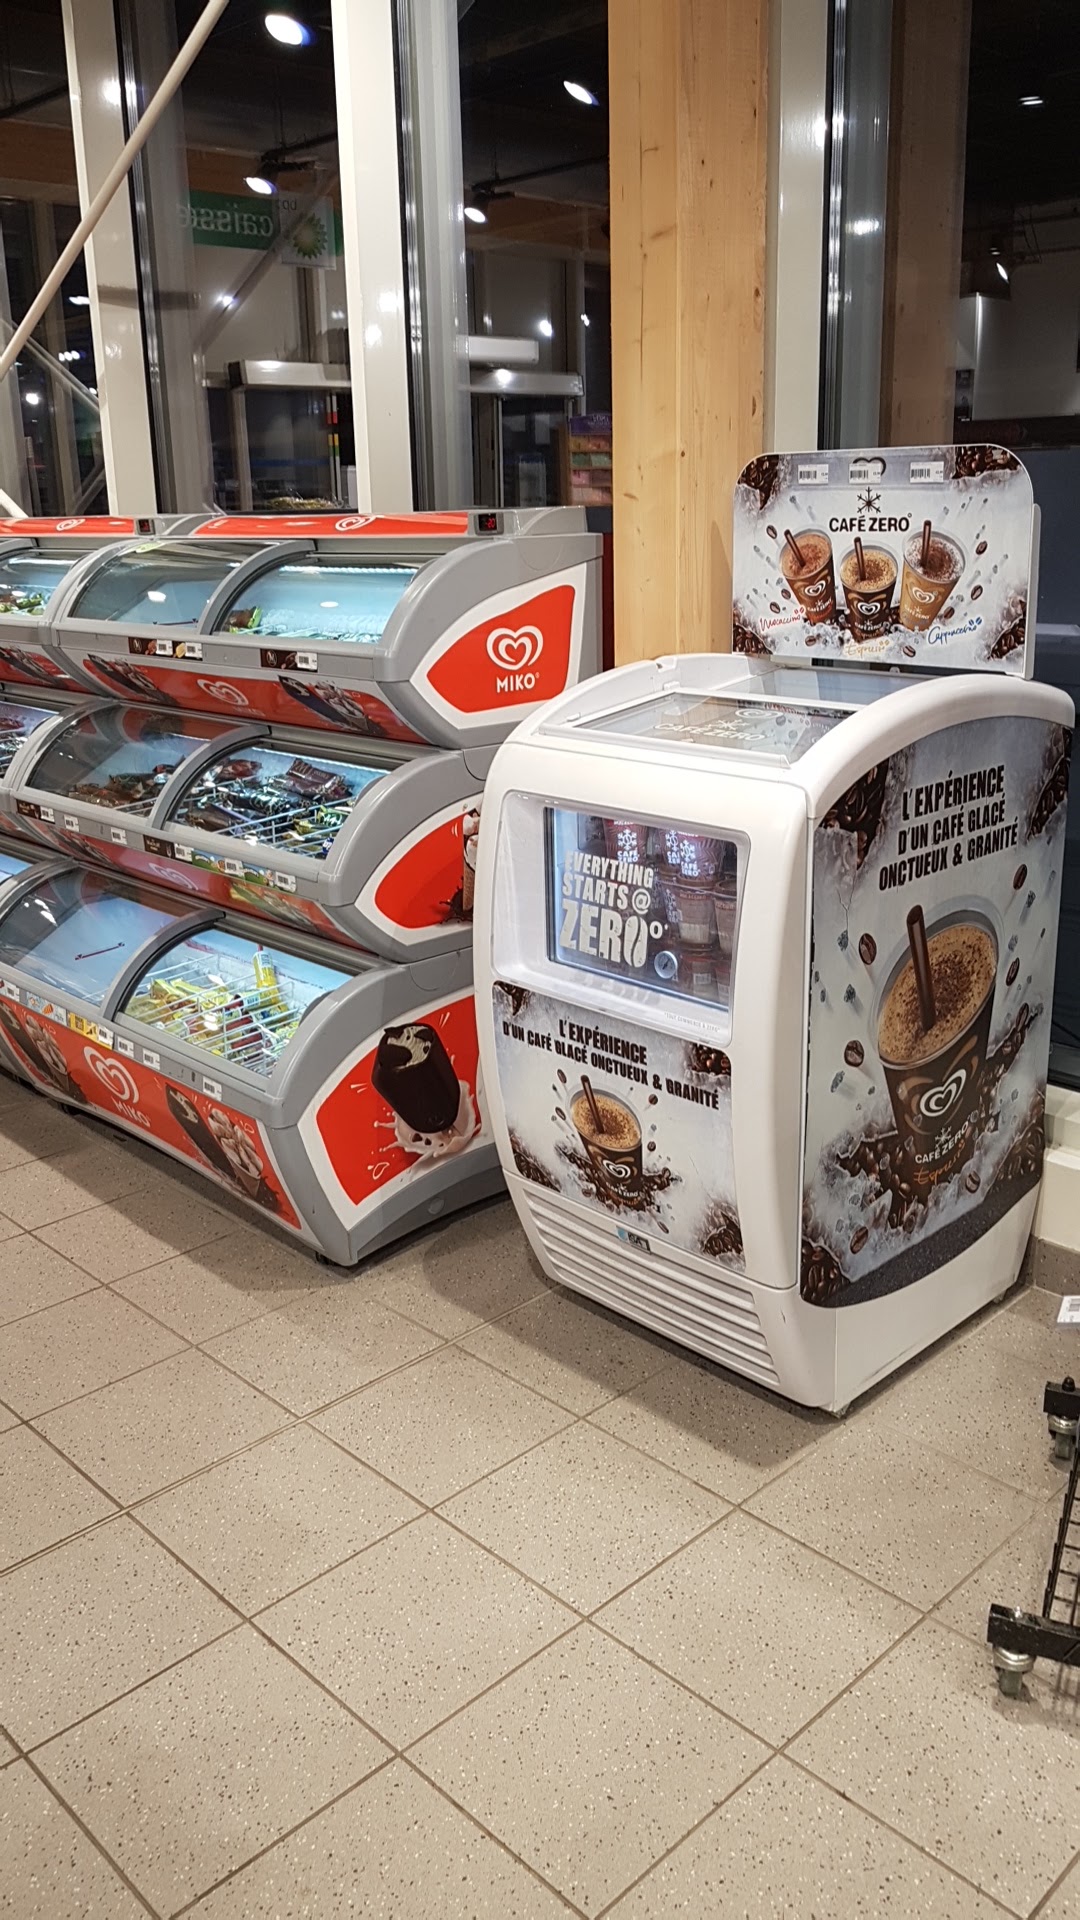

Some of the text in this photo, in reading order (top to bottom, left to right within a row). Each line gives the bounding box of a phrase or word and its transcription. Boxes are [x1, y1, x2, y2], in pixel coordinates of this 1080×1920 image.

[829, 515, 866, 532] CAFÉ
[496, 672, 536, 693] MIKO
[902, 764, 1005, 821] L'EXPÉRIENCE
[898, 794, 1006, 856] D'UN CAFÉ GLACÉ
[564, 851, 654, 888] EVERYTHING
[879, 817, 1019, 891] ONCTUEUX & GRANITÉ
[562, 874, 629, 910] STARTS
[503, 1021, 720, 1110] D'UN CAFÉ GLACÉ ONCTUEUX & GRANITÉ
[559, 1018, 648, 1066] L'EXPÉRIENCE
